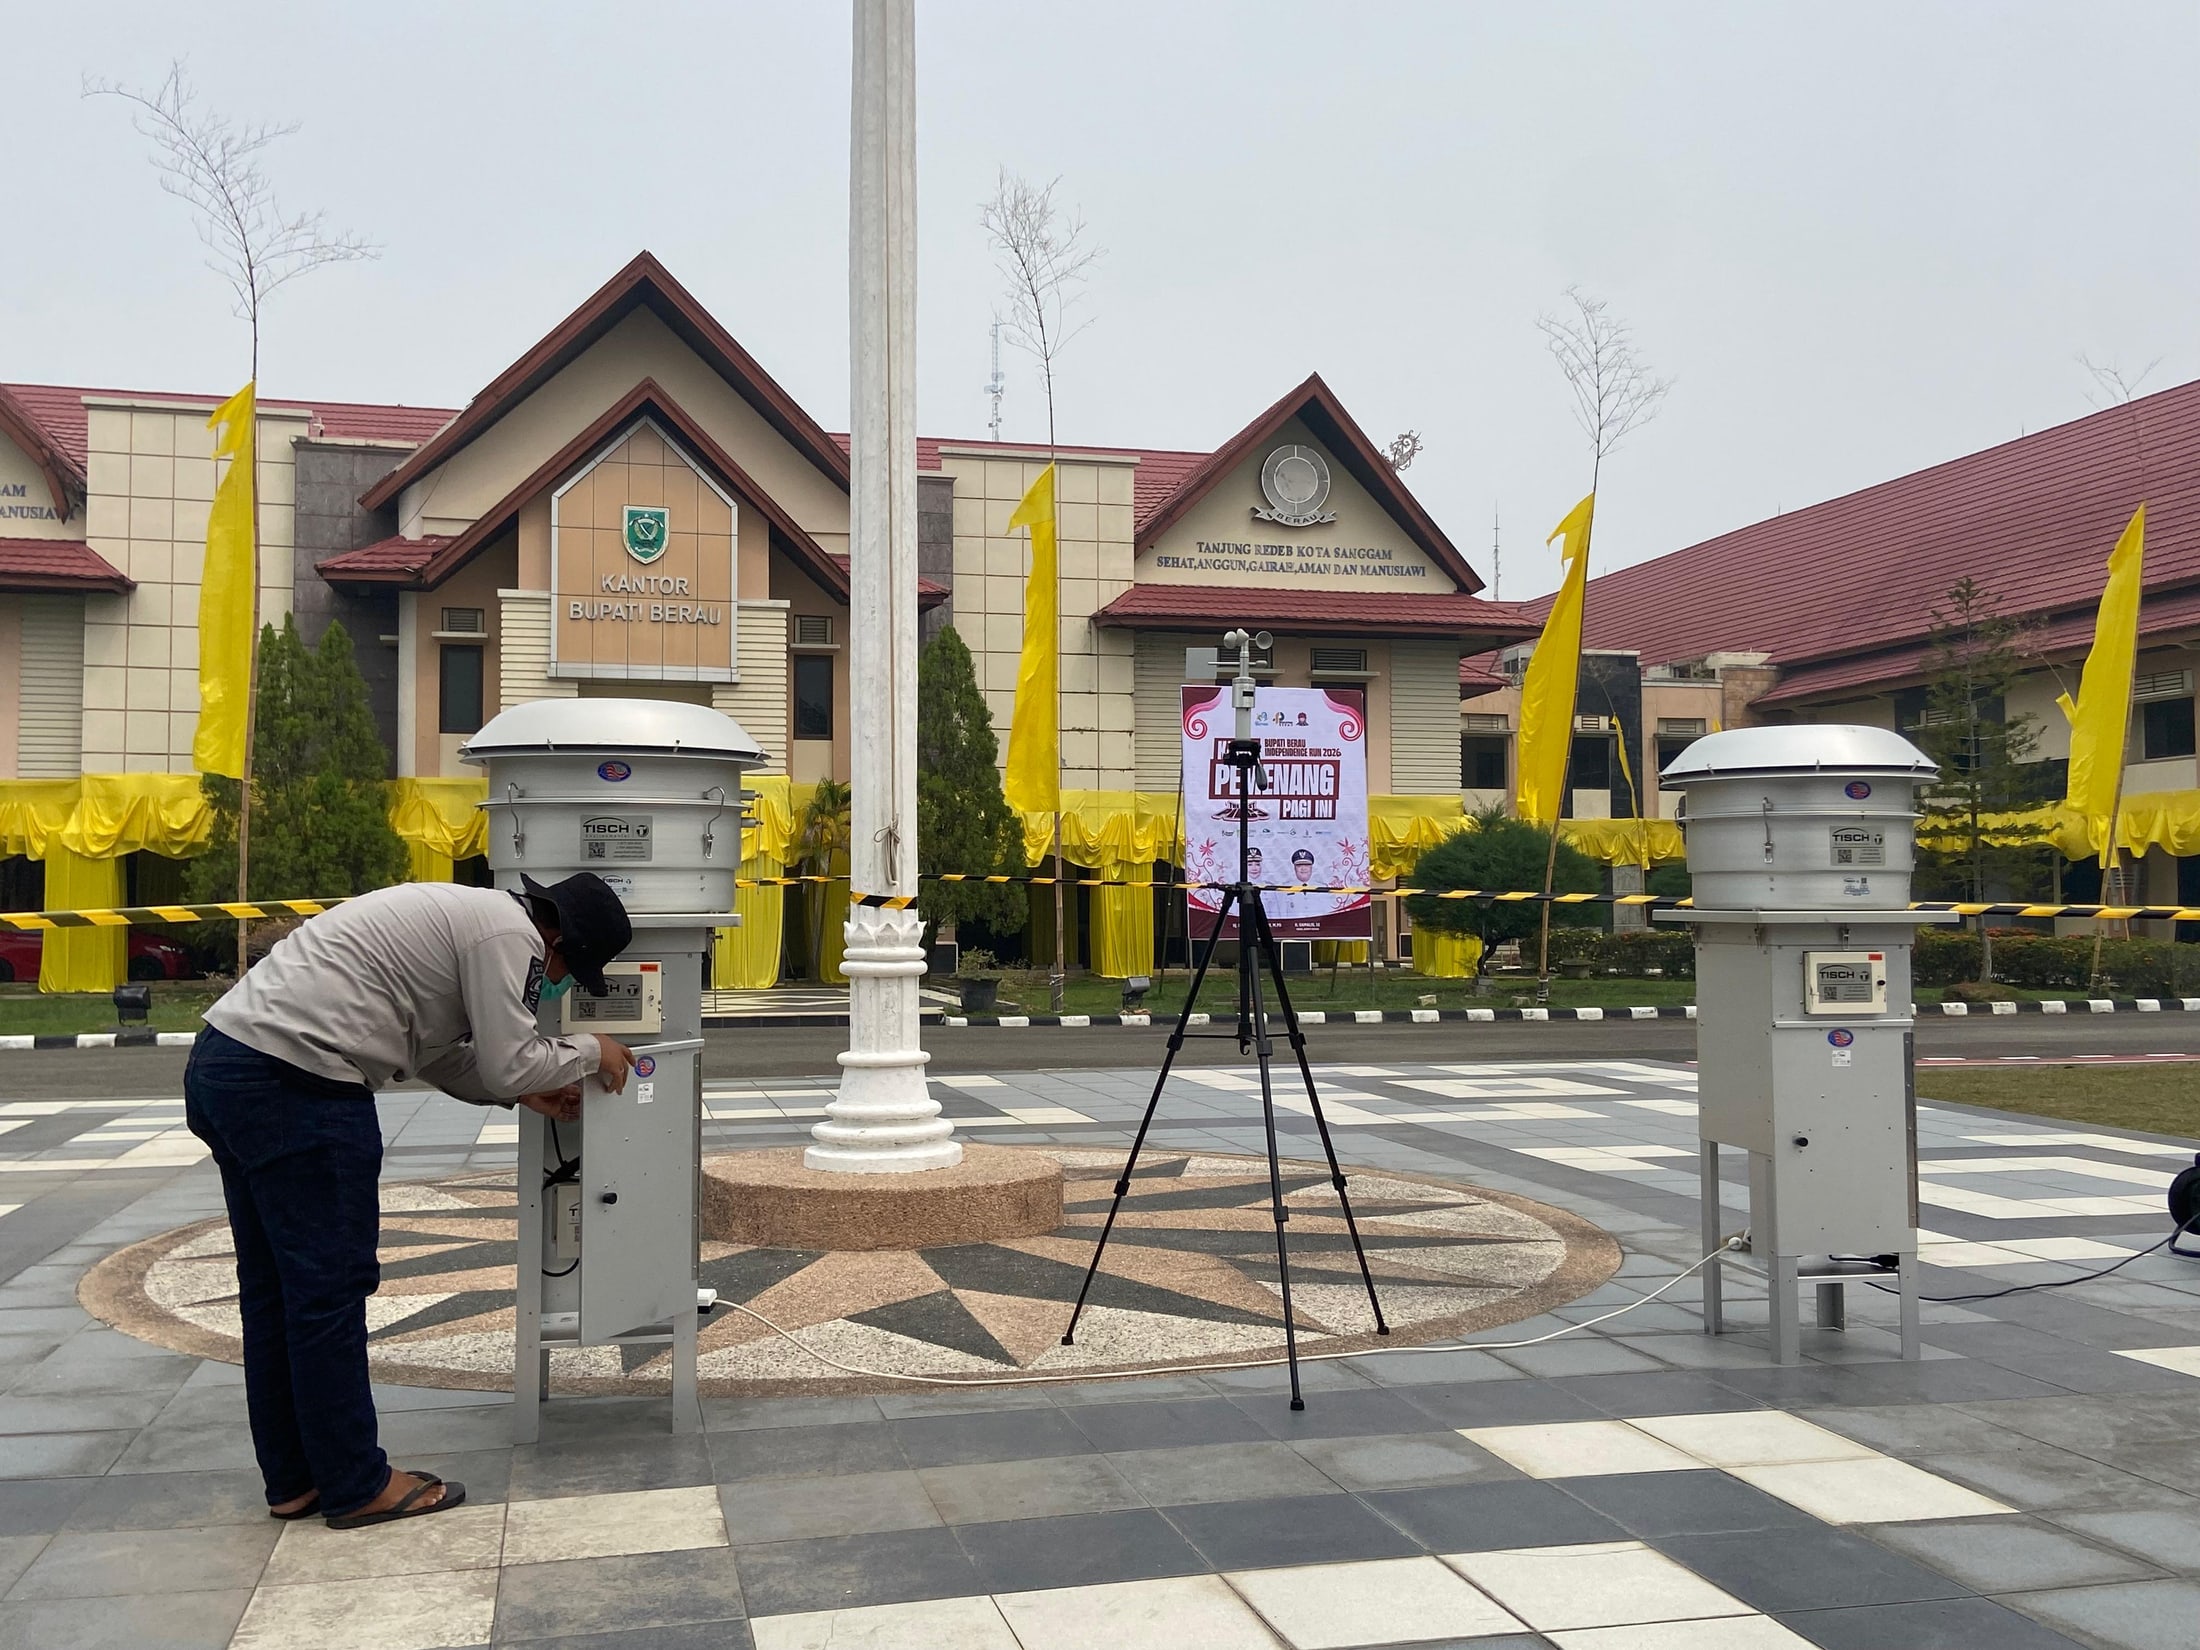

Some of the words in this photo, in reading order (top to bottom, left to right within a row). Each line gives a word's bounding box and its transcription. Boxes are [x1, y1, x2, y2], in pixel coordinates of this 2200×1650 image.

[0, 483, 27, 497] AM
[1276, 512, 1318, 524] BERAU
[1196, 541, 1251, 555] TANJUNG
[1254, 544, 1293, 557] REDEB
[1296, 545, 1333, 558] KOTA
[1334, 547, 1392, 560] SANGGAM
[1333, 563, 1357, 575] DAN
[1360, 564, 1426, 577] MANUSIAWI
[601, 573, 690, 595] KANTOR
[569, 601, 643, 622] BUPATI
[650, 604, 721, 625] BERAU
[1264, 739, 1286, 748] BUPATI
[1286, 739, 1306, 748] BERAU
[1264, 748, 1308, 757] INDEPENDENCE
[1322, 748, 1342, 757] 2026
[1282, 800, 1311, 818] PAGI
[1315, 800, 1333, 818] INI
[582, 824, 630, 833] TISCH
[1831, 834, 1870, 842] TISCH
[1819, 971, 1855, 979] TISCH
[573, 983, 620, 993] TIH
